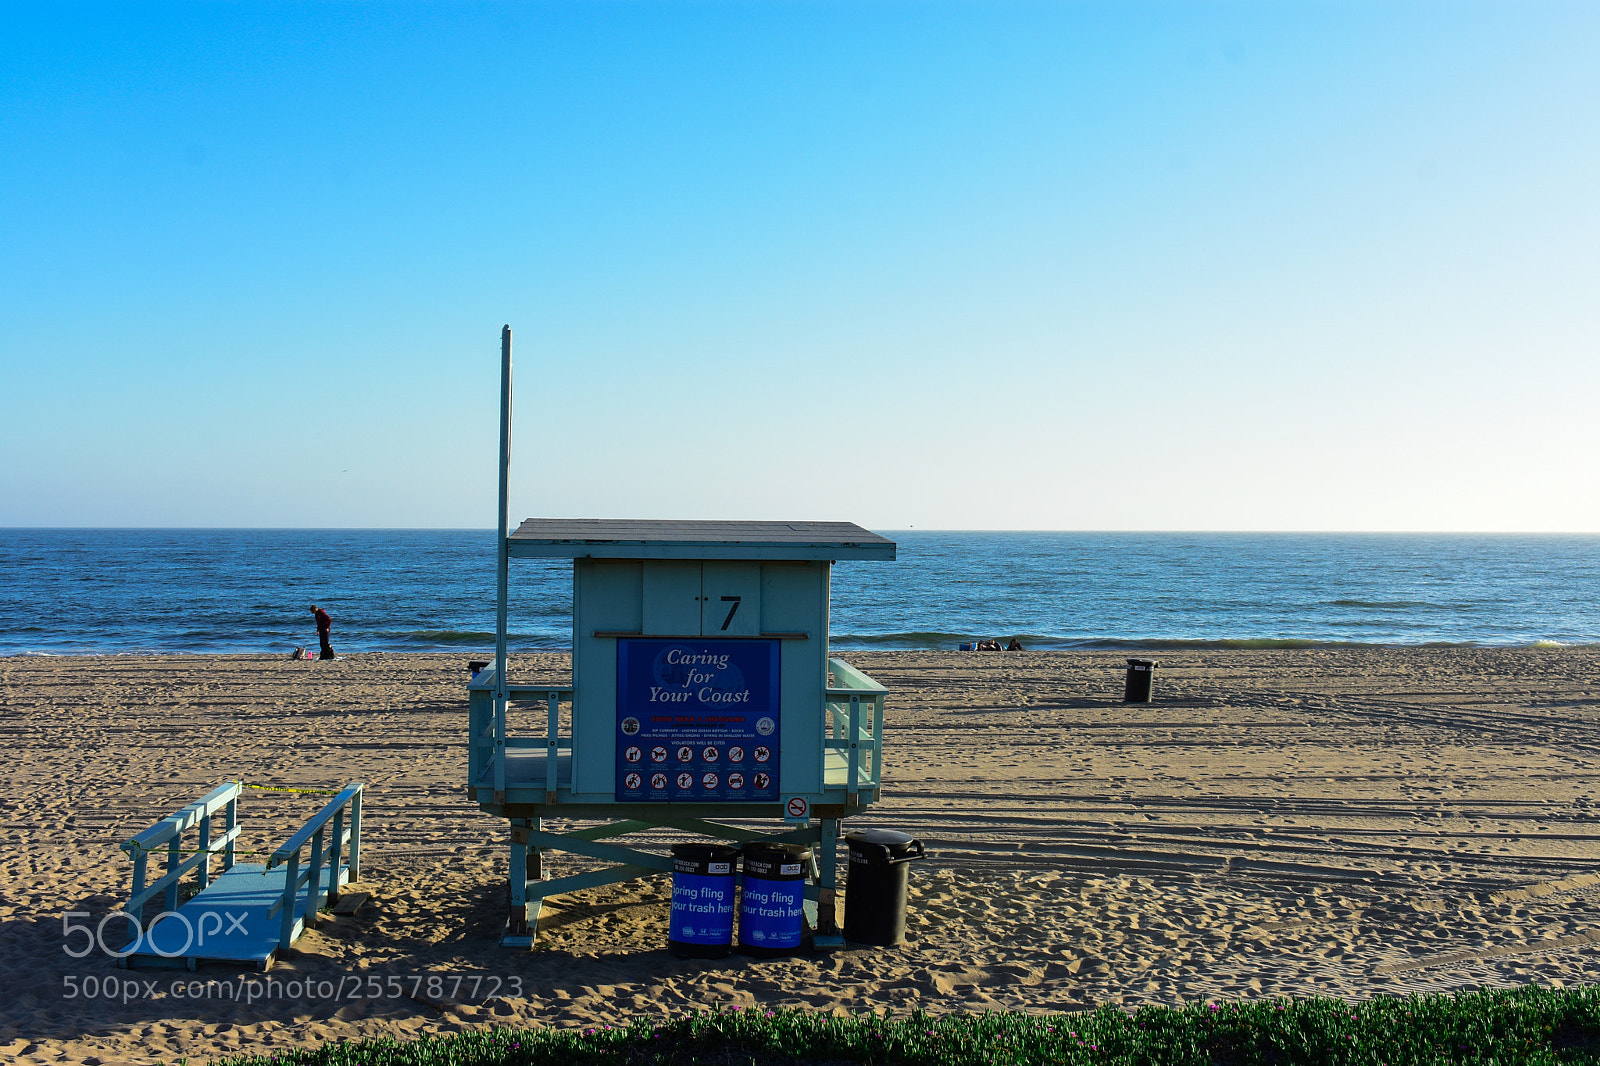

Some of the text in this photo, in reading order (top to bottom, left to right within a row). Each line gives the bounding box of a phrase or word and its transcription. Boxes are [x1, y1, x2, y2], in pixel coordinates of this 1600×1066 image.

[720, 596, 741, 631] 7
[667, 649, 730, 670] Caring
[682, 668, 714, 688] for
[650, 686, 750, 702] Your Coast
[700, 887, 724, 901] fling
[771, 892, 794, 905] fling
[688, 902, 715, 913] trash
[742, 905, 757, 915] our
[759, 907, 785, 917] trash
